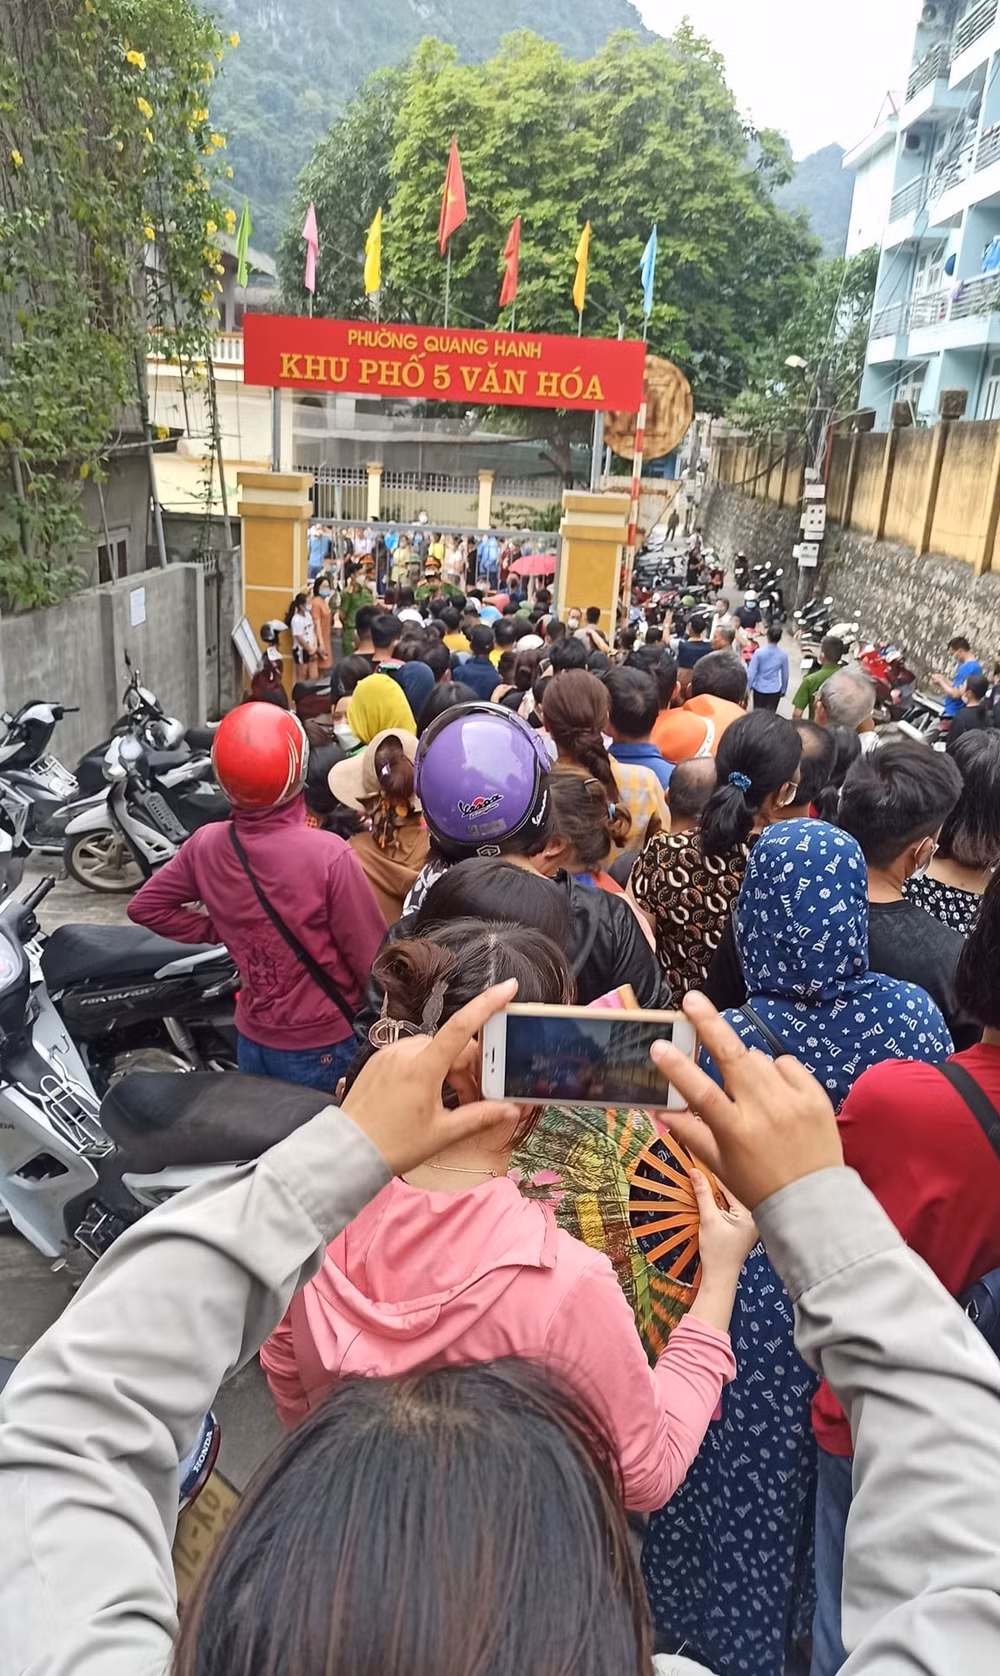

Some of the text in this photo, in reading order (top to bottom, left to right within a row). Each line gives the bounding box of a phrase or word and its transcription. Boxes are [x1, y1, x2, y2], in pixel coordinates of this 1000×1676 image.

[348, 327, 542, 359] PHƯỜNG QUANG HANH
[279, 352, 605, 400] KHU PHỐ 5 VĂN HÓA
[795, 833, 812, 852] Dior
[824, 853, 842, 875] Dior
[793, 877, 812, 901] Dior
[811, 930, 832, 953] Dior
[829, 998, 848, 1020] Dior
[781, 1011, 808, 1033] Dior
[861, 1022, 885, 1040] Dior
[899, 1012, 918, 1032] Dior
[820, 1036, 843, 1058] Dior
[883, 1037, 905, 1058] Dior
[927, 1031, 944, 1053] Dior
[842, 1053, 862, 1075] Dior
[749, 1241, 766, 1260] Dior
[773, 1300, 793, 1323] Dior
[763, 1336, 783, 1354] Dior
[761, 1389, 780, 1411] Dior
[193, 1430, 213, 1474] HONDA
